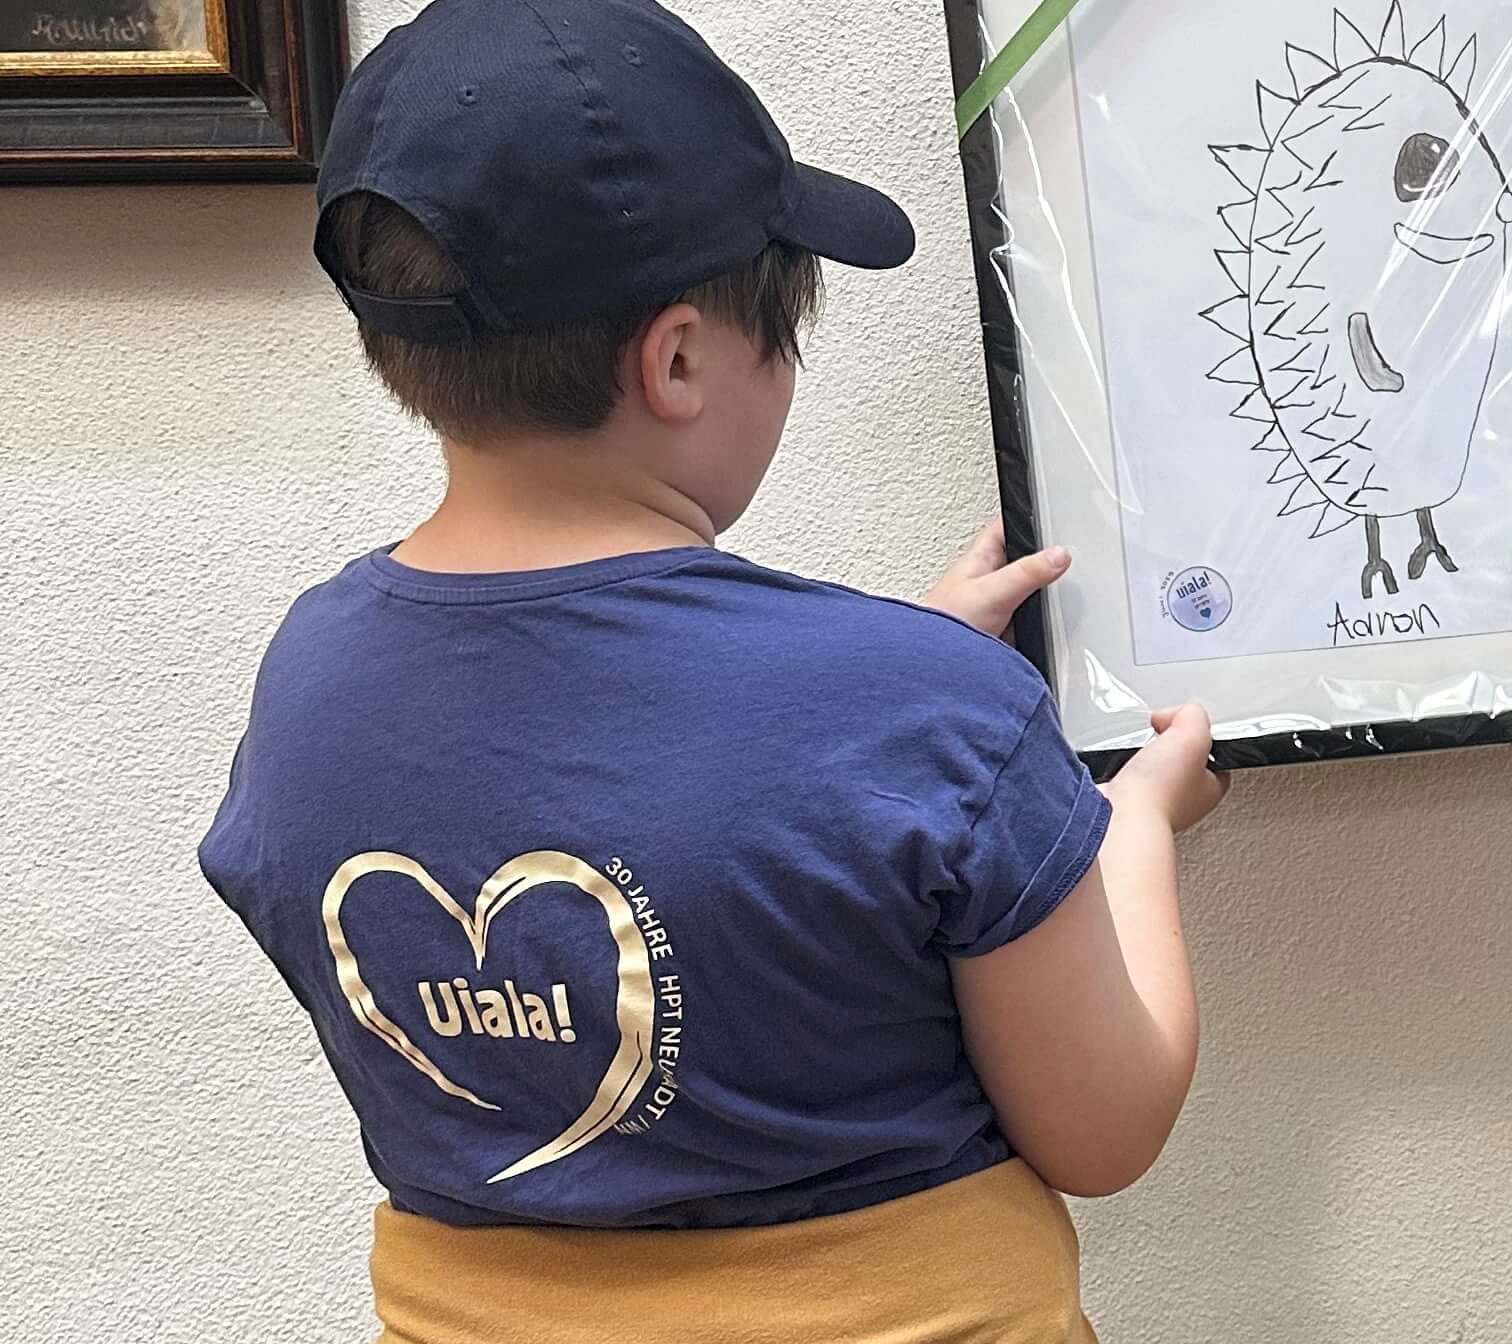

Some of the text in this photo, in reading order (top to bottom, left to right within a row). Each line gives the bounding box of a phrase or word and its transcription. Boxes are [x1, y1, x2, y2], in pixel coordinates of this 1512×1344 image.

[605, 857, 633, 885] 30
[627, 885, 674, 961] JAHRE
[658, 975, 683, 1021] HPT
